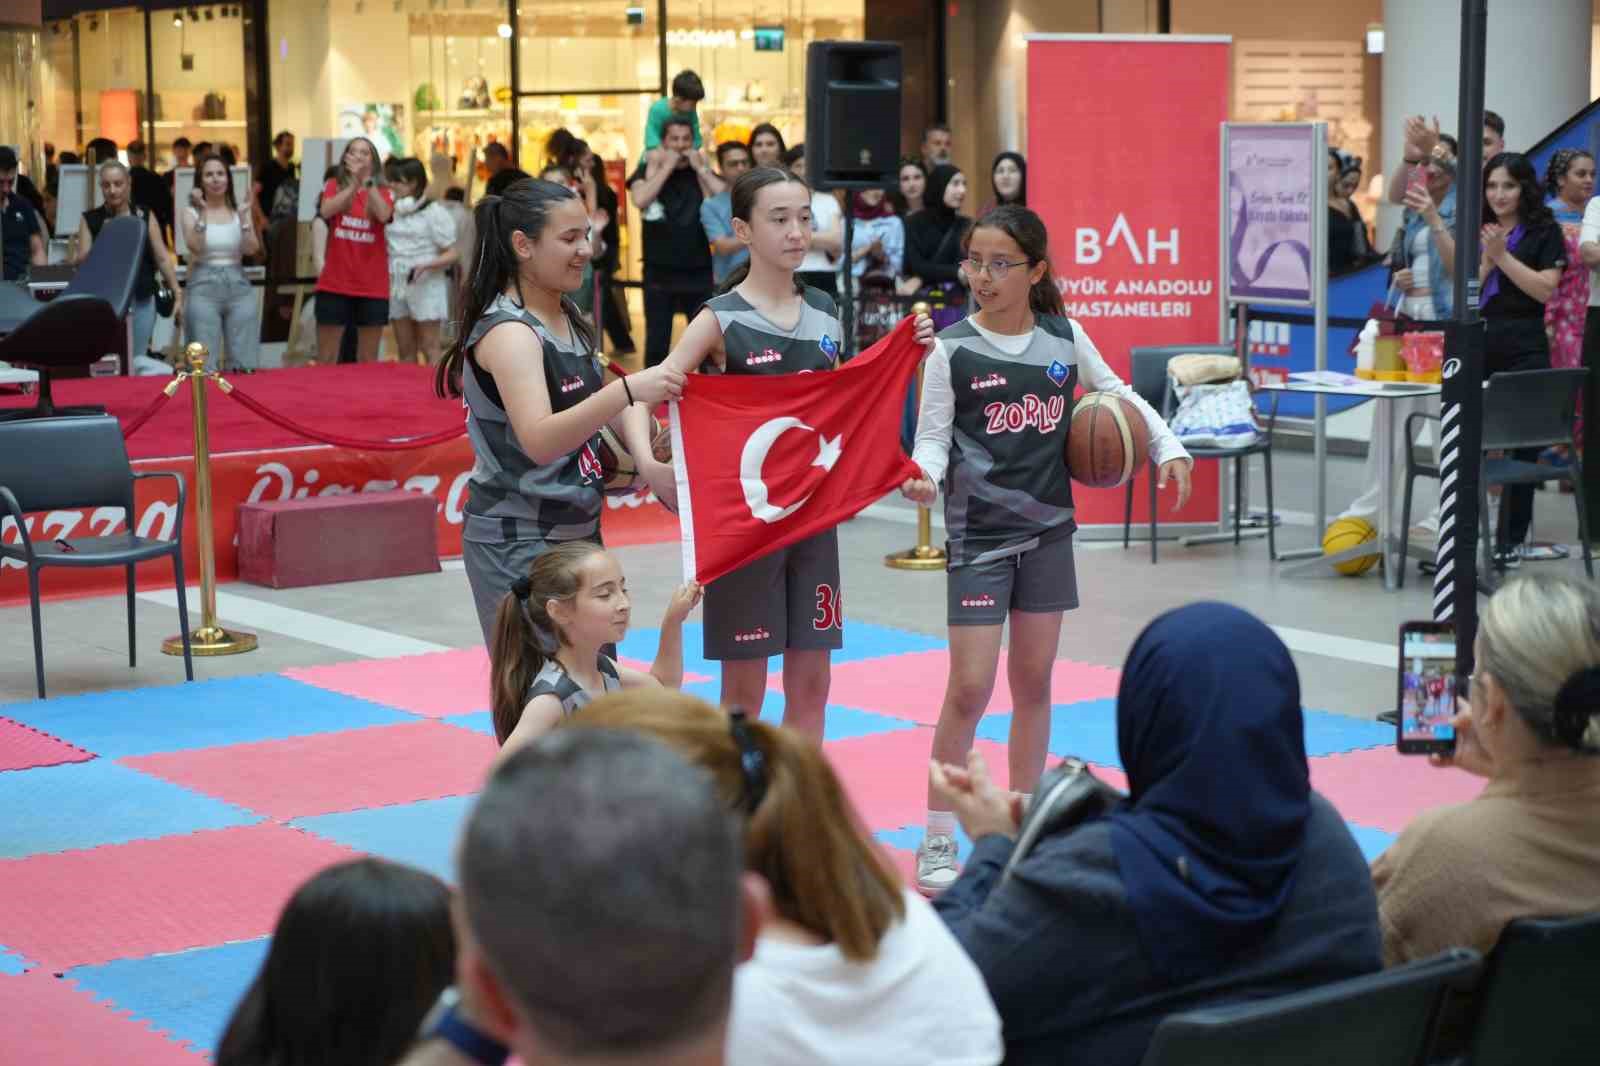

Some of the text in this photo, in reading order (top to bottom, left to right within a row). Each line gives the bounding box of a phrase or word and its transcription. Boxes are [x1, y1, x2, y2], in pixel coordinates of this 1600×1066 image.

[1054, 276, 1213, 296] ÜYÜK ANADOLU
[984, 394, 1065, 434] ZORLU
